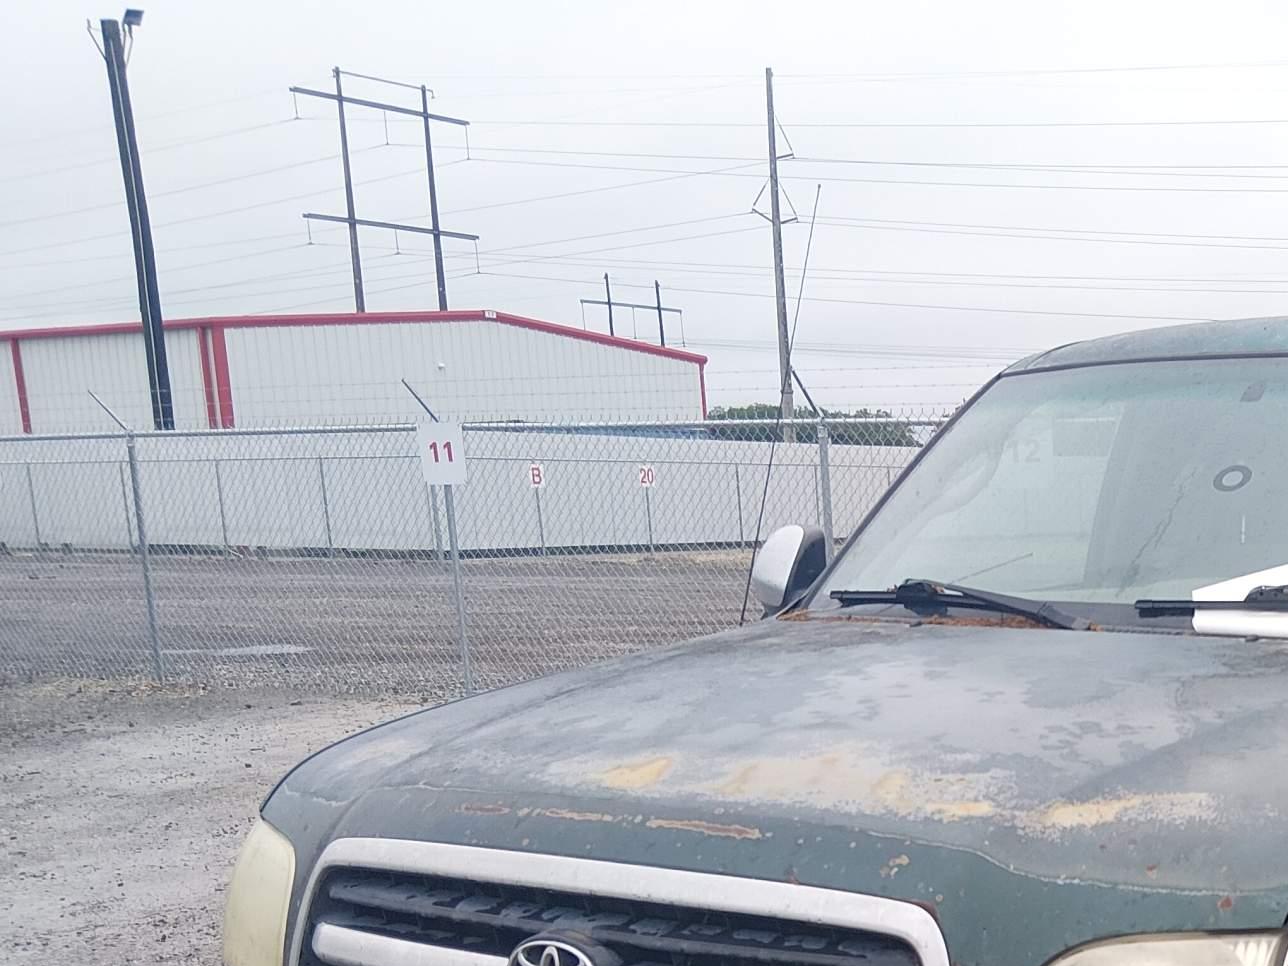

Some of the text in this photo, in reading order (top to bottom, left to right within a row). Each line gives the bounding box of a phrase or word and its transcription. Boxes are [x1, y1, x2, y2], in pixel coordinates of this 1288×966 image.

[429, 441, 454, 463] 11
[531, 467, 543, 485] B
[640, 467, 655, 484] 20
